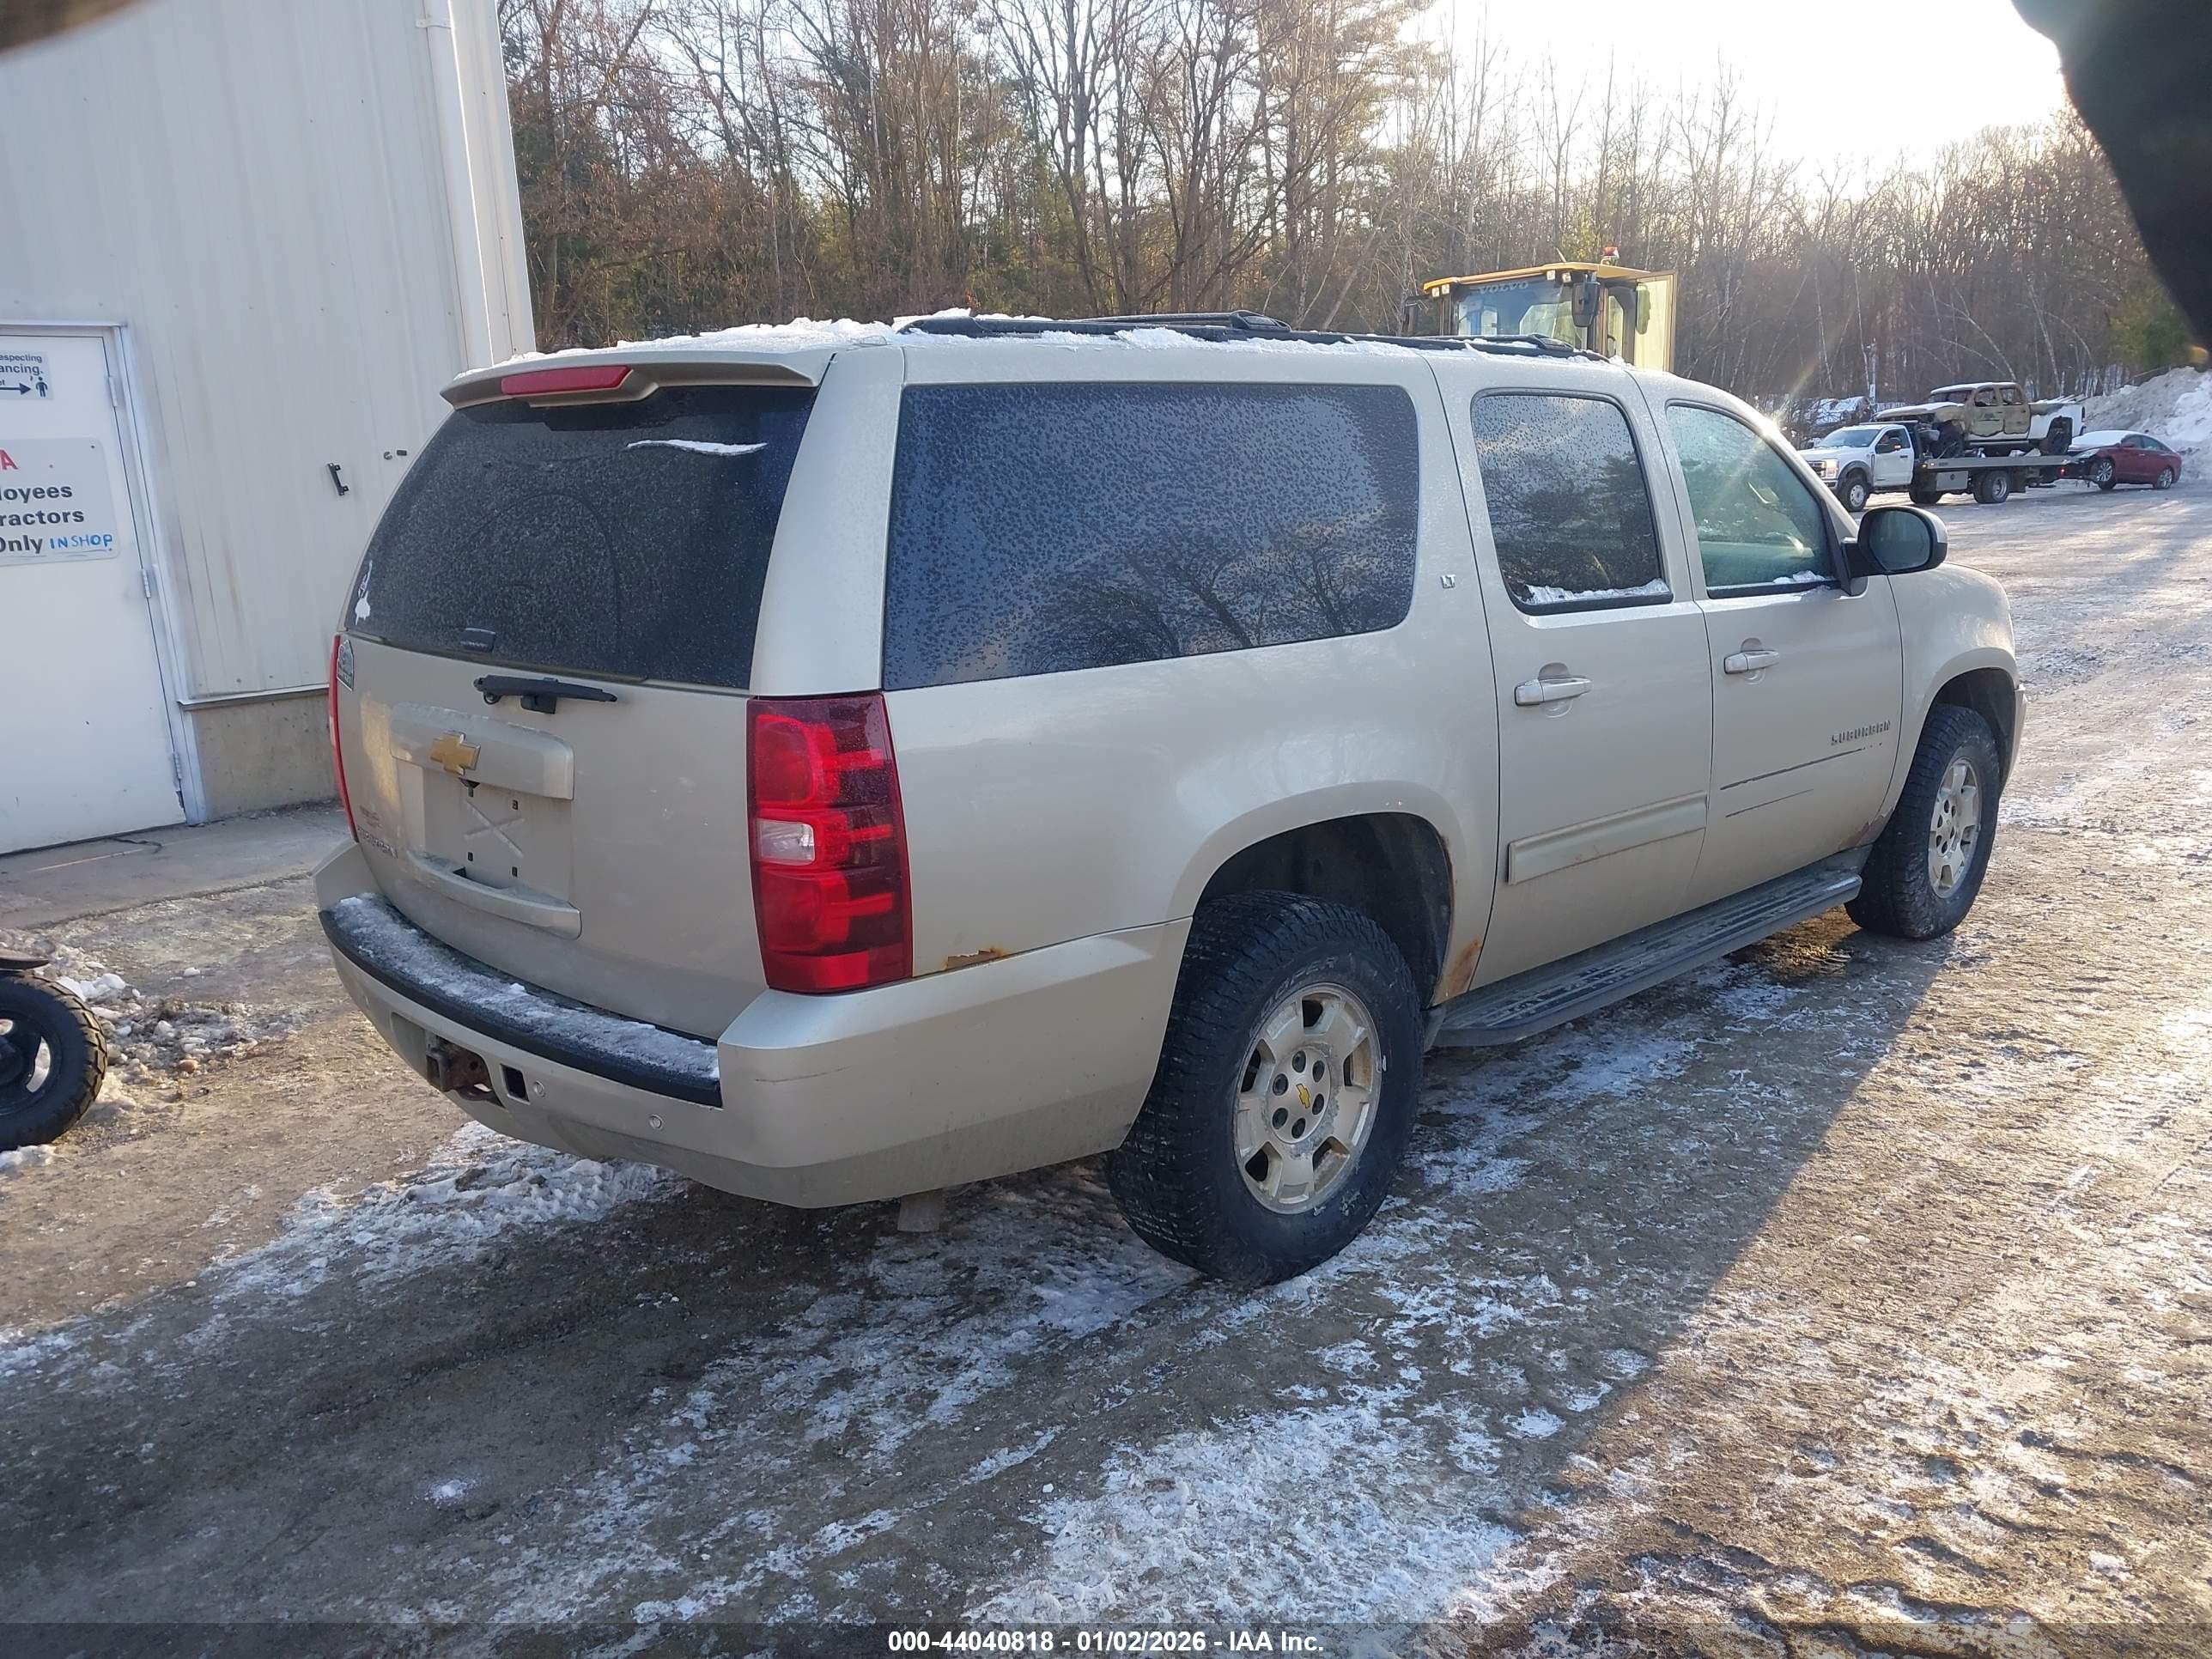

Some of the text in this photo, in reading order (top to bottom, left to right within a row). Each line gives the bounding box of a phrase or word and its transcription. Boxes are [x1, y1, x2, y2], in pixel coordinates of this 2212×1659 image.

[1480, 281, 1529, 294] VOLVO
[0, 509, 84, 527] ractors
[1440, 574, 1455, 588] LT
[1830, 720, 1891, 744] SUBURBAN
